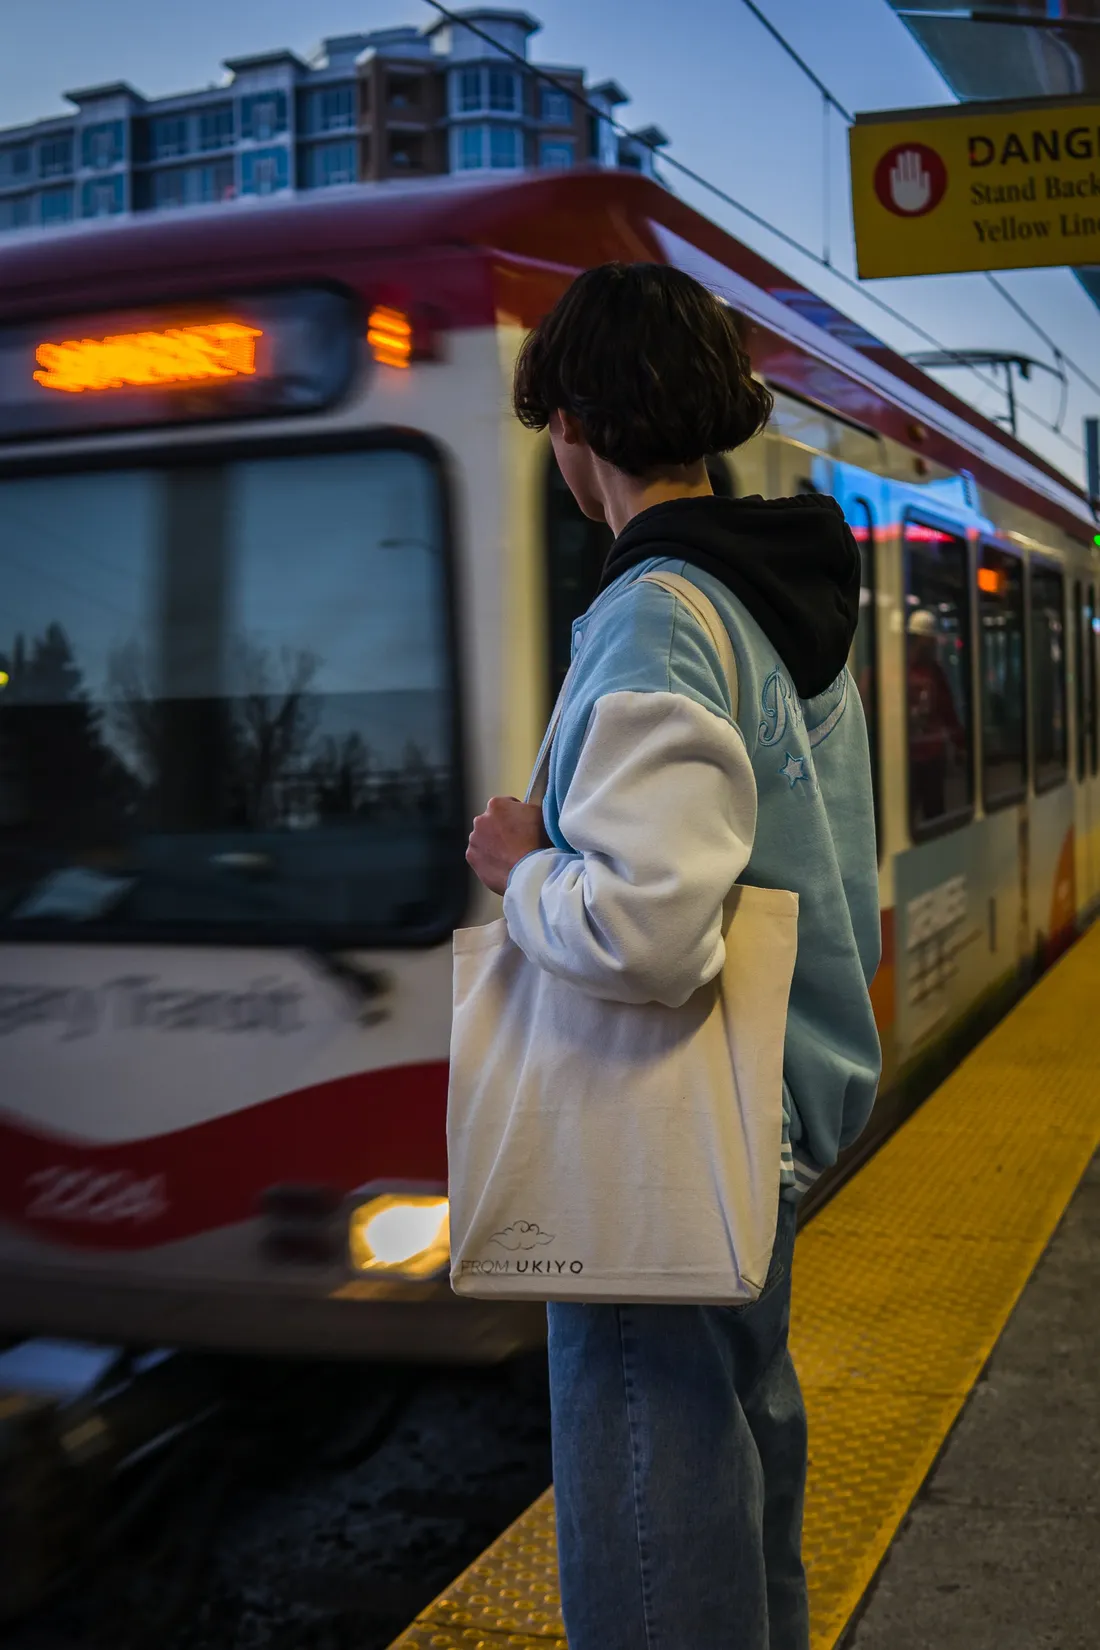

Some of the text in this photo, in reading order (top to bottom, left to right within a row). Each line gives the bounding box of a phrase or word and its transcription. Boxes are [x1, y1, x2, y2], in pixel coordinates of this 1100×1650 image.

[968, 126, 1100, 167] DANG
[970, 176, 1037, 206] Stand
[973, 216, 1051, 243] Yellow
[461, 1259, 583, 1274] FROM UKIYO
